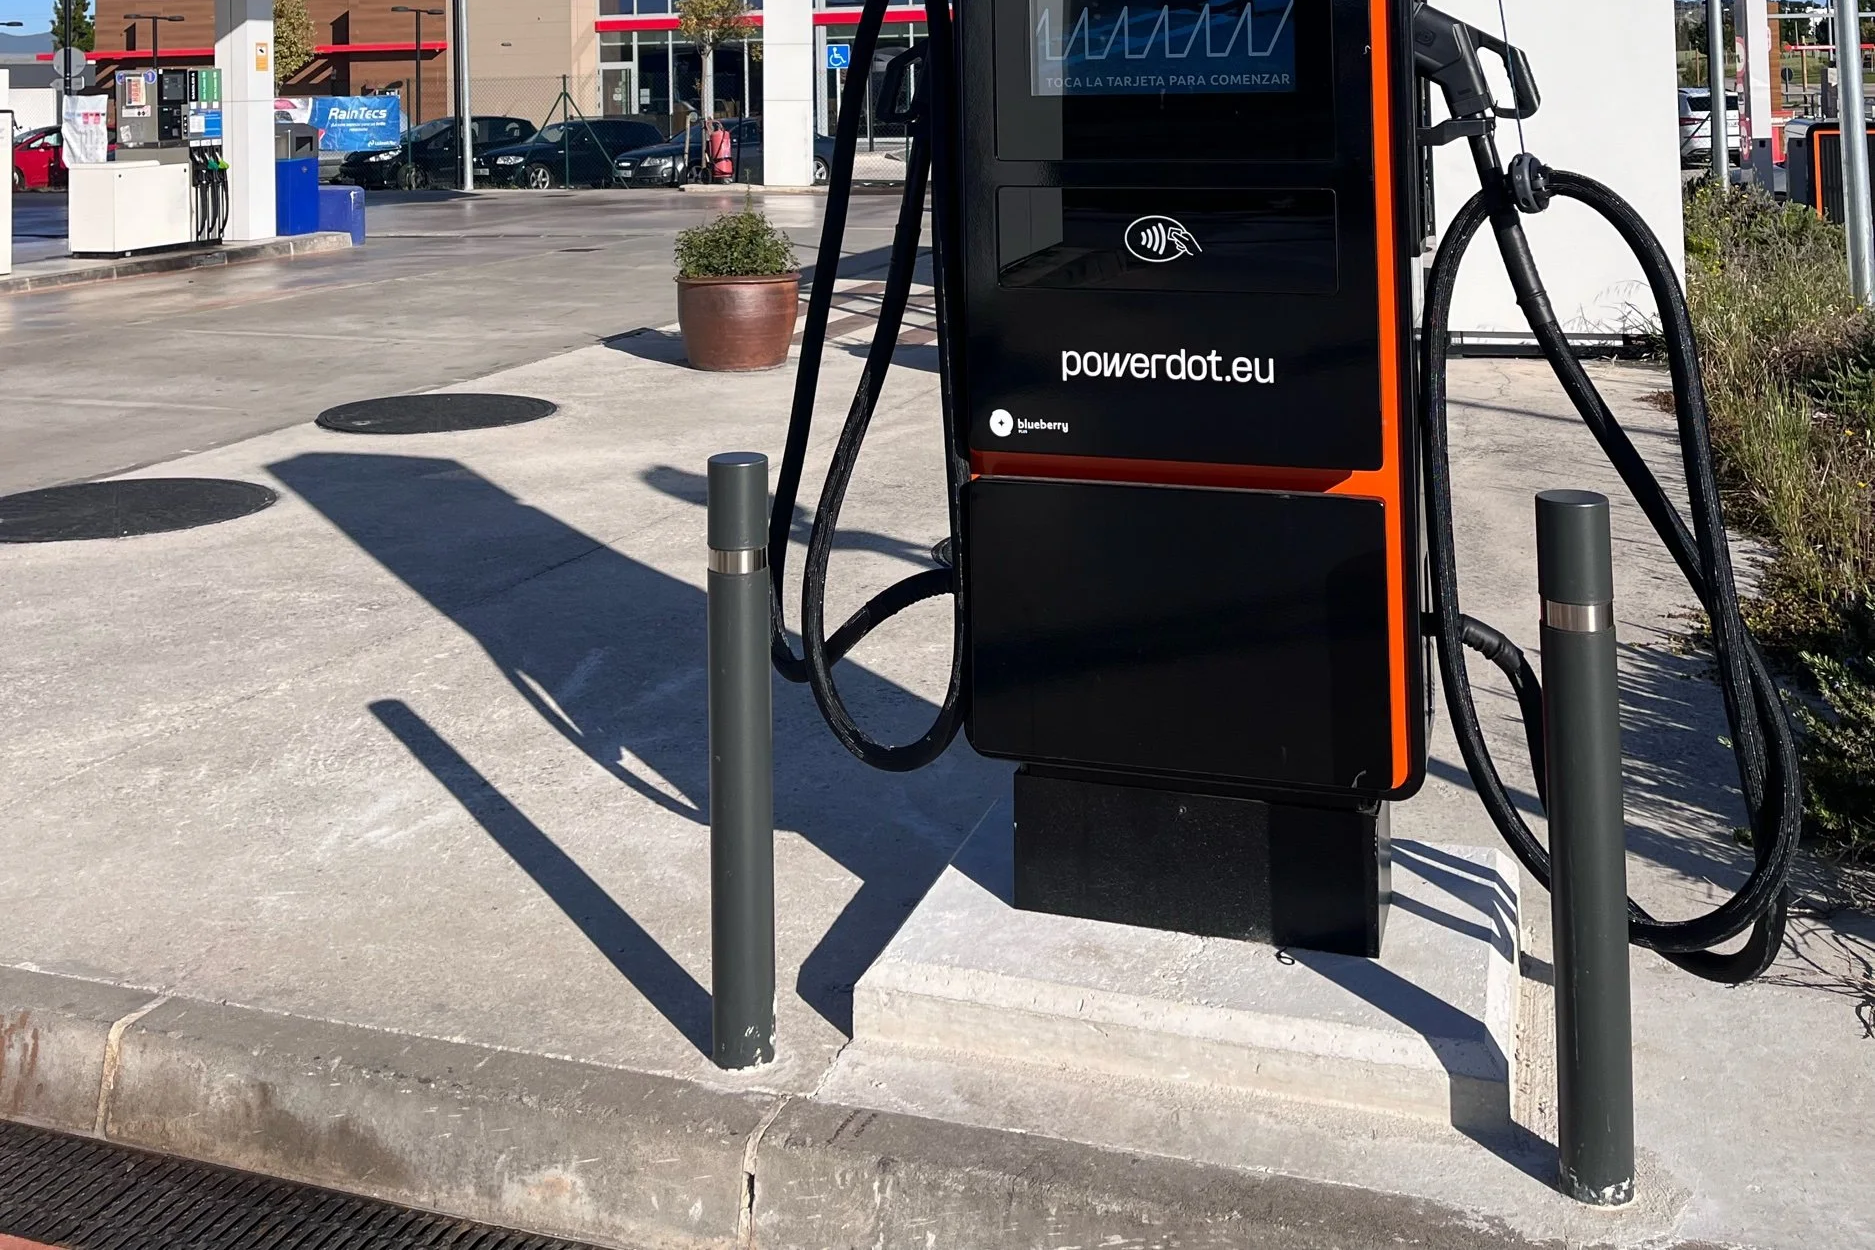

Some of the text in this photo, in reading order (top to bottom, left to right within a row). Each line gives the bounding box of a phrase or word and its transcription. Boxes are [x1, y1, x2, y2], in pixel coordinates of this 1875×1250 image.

[1046, 73, 1290, 88] TOCA LA TARJETA PARA COMENZAR
[329, 107, 387, 120] RainTecs
[1062, 349, 1275, 384] powerdot.eu
[1017, 418, 1069, 433] blueberry
